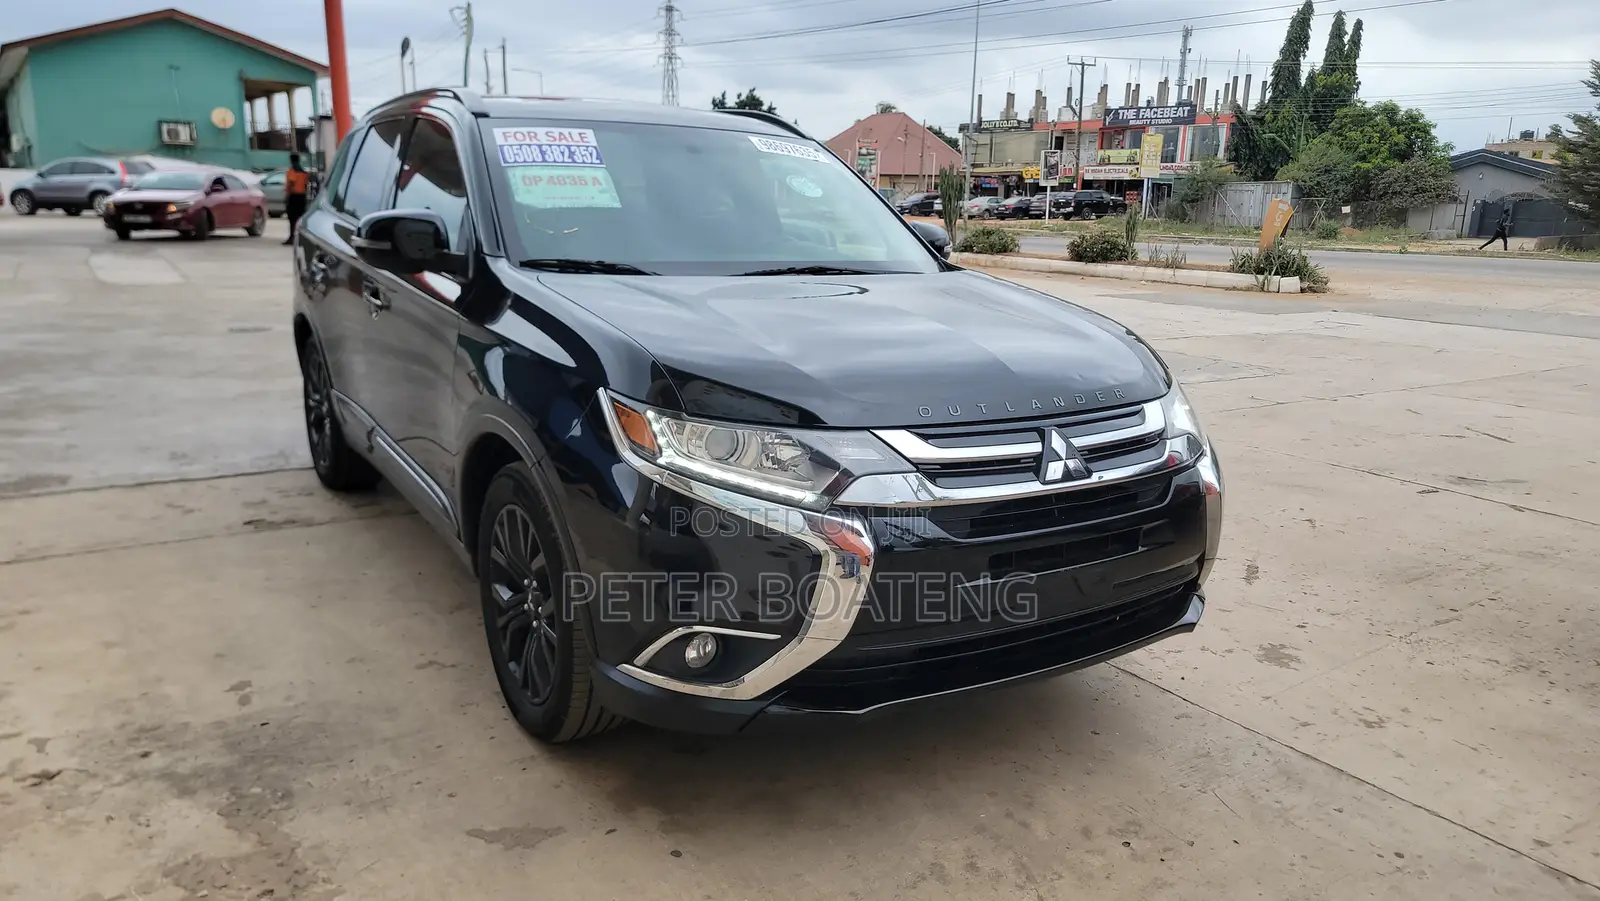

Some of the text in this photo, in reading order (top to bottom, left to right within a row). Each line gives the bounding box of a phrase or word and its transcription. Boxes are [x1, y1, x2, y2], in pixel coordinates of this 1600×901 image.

[1118, 106, 1190, 120] THE FACEBEAT
[502, 131, 590, 144] FOR SALE
[503, 145, 601, 164] 0508 382 352
[917, 387, 1125, 418] OUTLANDER
